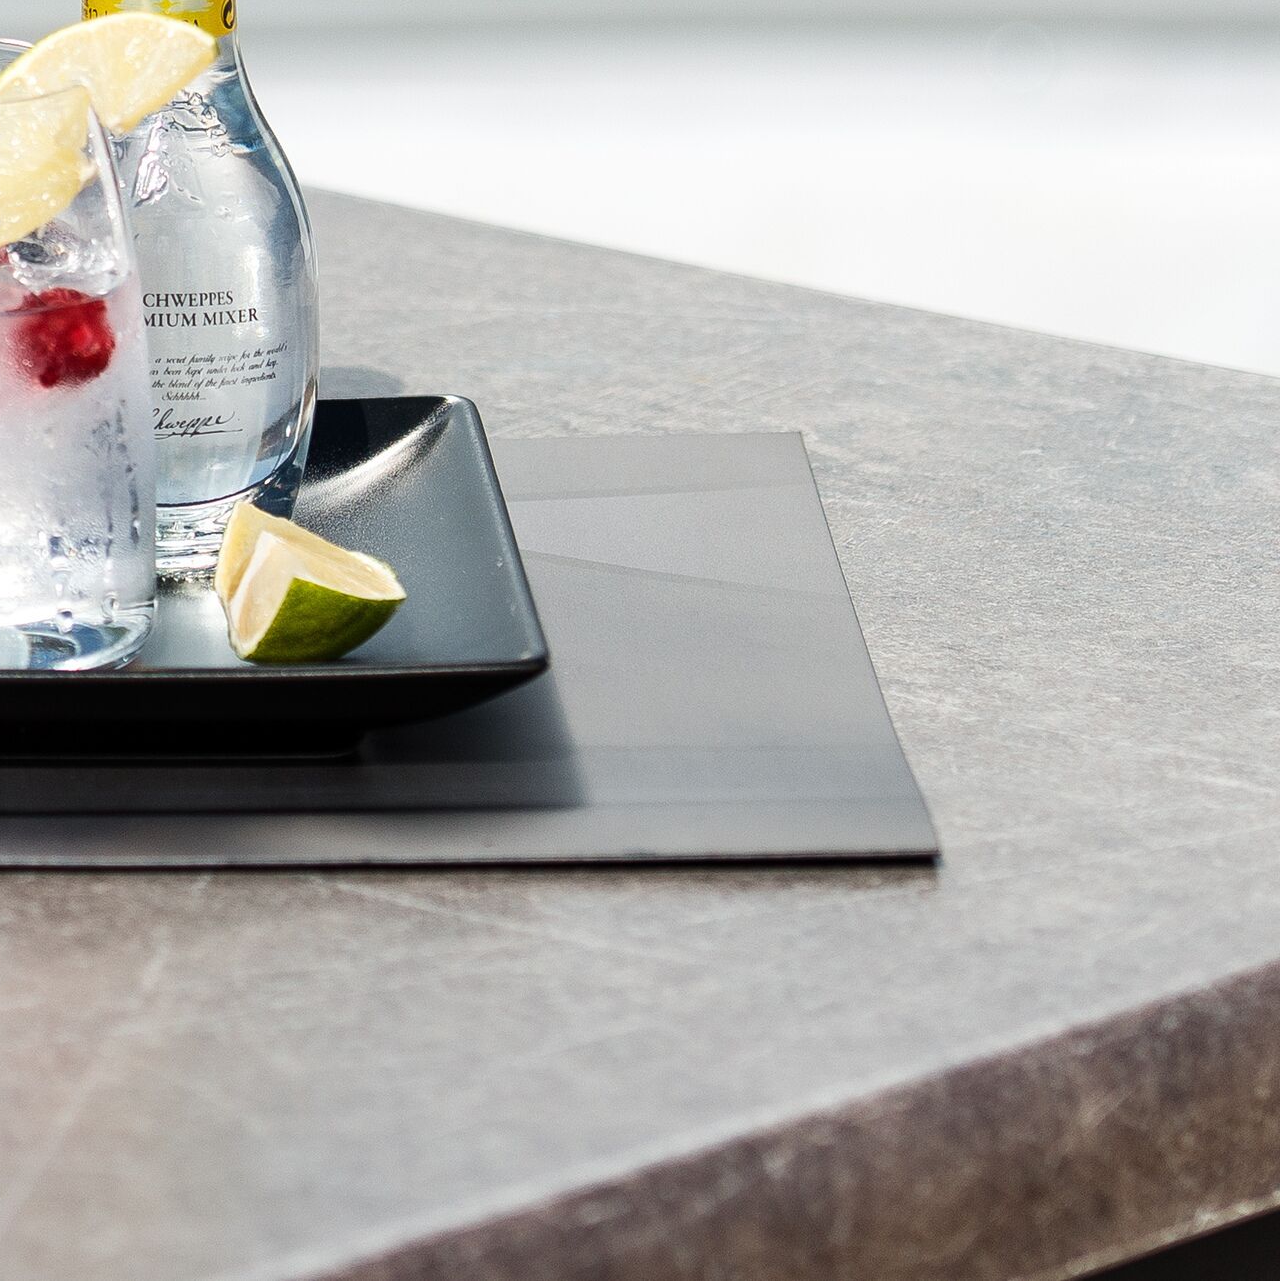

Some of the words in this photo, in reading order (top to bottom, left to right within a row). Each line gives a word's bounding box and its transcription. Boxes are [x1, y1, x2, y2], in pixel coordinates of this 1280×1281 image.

[142, 290, 234, 308] CHWEPPES
[143, 311, 197, 328] MIUM
[202, 307, 259, 327] MIXER
